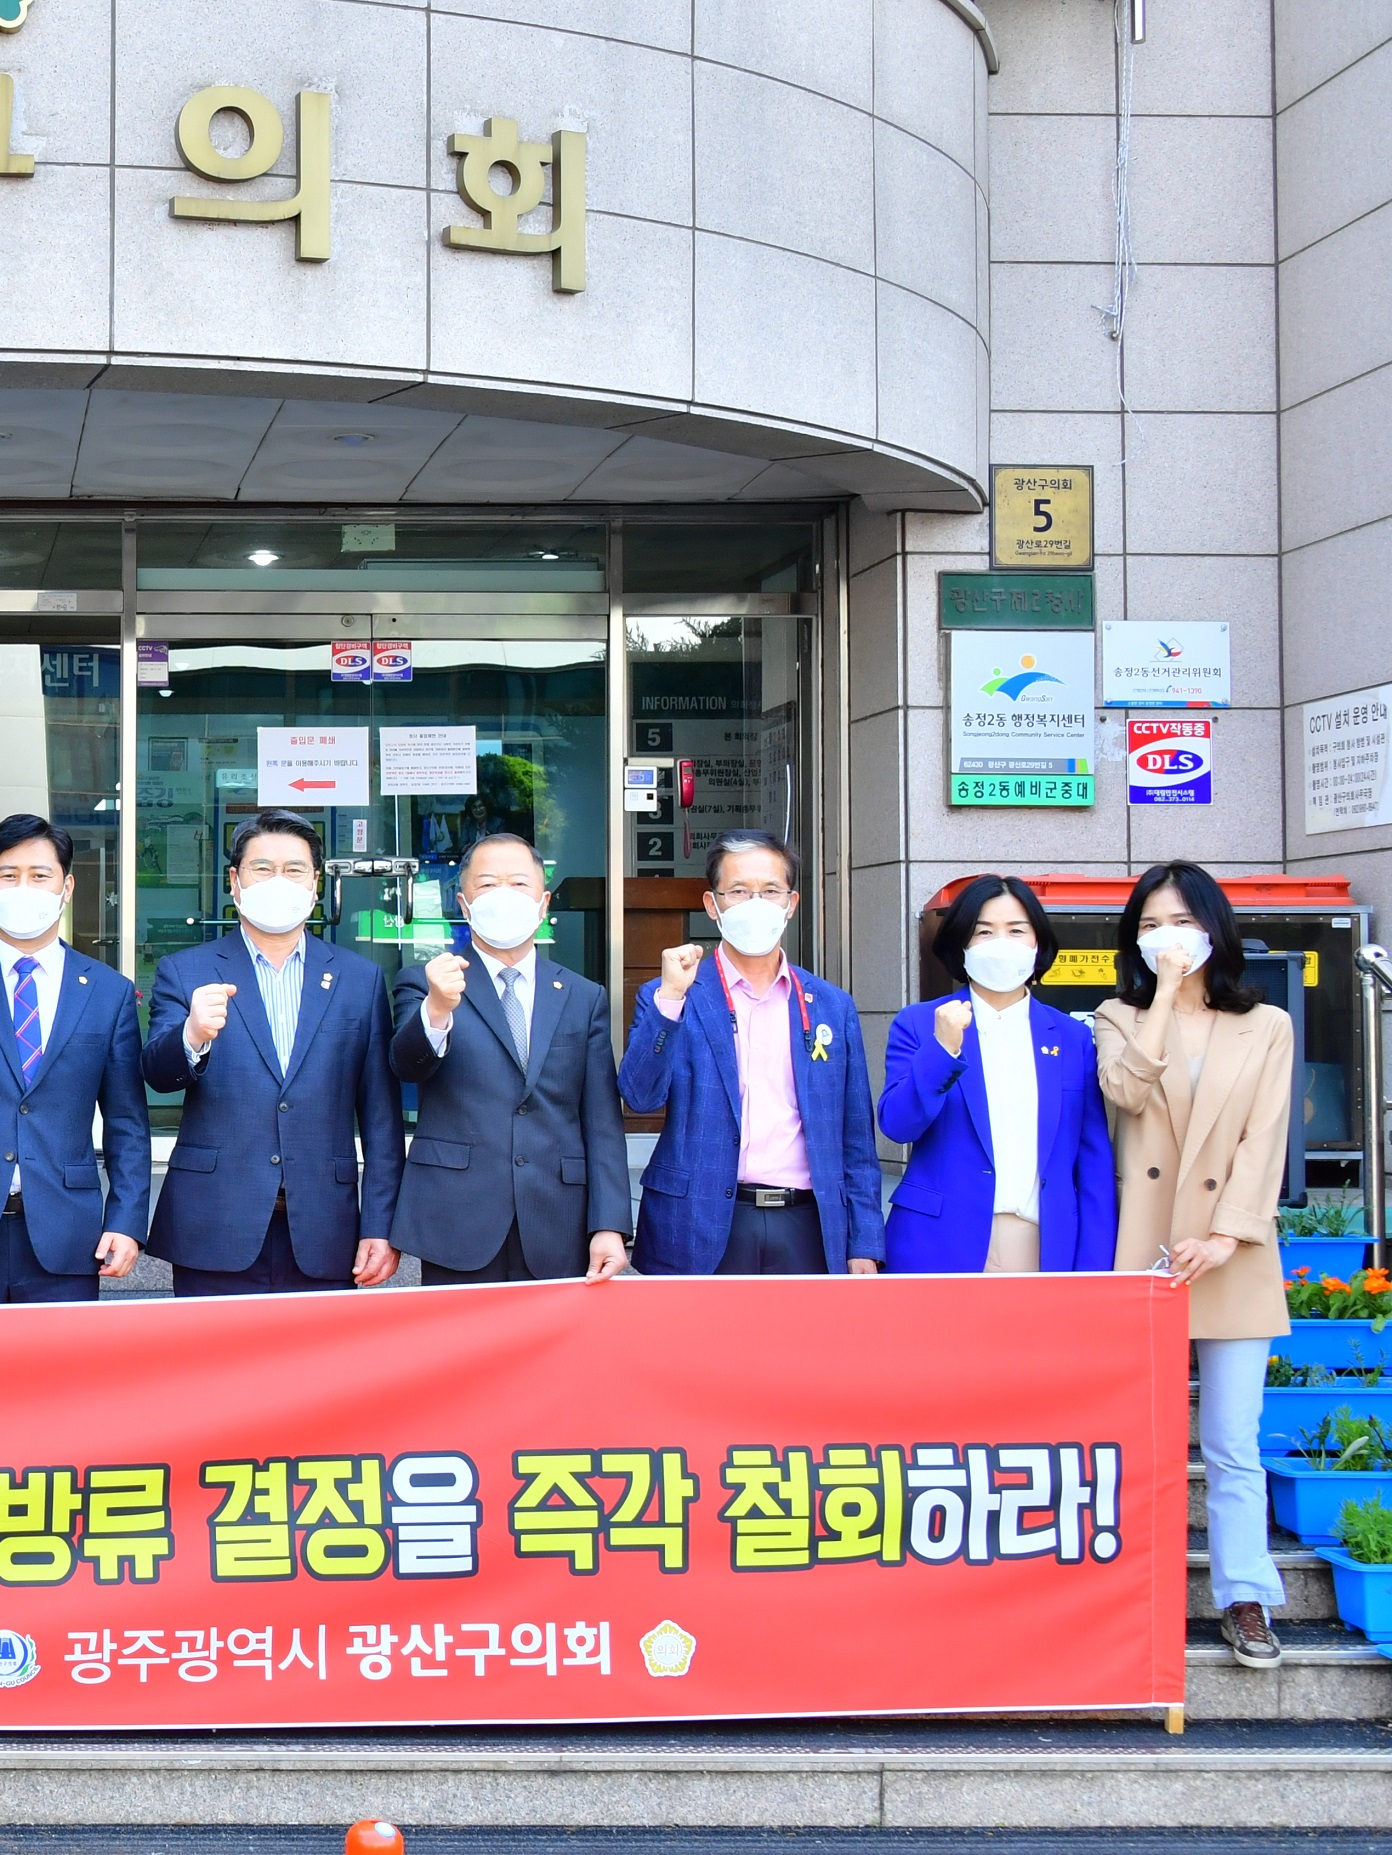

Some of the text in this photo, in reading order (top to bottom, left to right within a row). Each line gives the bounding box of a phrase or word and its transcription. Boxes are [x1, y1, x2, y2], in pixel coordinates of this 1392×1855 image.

[1013, 478, 1072, 491] 광산구의회
[1033, 498, 1053, 533] 5
[1016, 539, 1071, 550] 광산로29번길
[340, 657, 363, 665] DLS
[382, 657, 404, 665] DLS
[1114, 667, 1222, 678] 송정2동선거관리위원회
[642, 696, 726, 710] INFORMATION
[962, 713, 1085, 728] 송정2동 행정복지센터
[1310, 702, 1387, 734] CCTV 설치 운영 안내
[1133, 723, 1205, 736] CCTV작동중
[290, 736, 315, 745] 출입문
[648, 728, 661, 746] 5
[1146, 754, 1194, 770] DLS
[958, 780, 1088, 800] 송정2동예비군중대
[688, 804, 724, 814] 원실(7실),
[648, 838, 662, 856] 2
[1058, 954, 1110, 964] 형폐가전수
[199, 1450, 483, 1584] 결정을
[509, 1446, 699, 1576] 즉각
[720, 1441, 1123, 1573] 철회하라!
[64, 1619, 612, 1685] 광주광역시 광산구의회
[657, 1644, 678, 1656] 의회
[16, 1666, 40, 1684] COUNCIL
